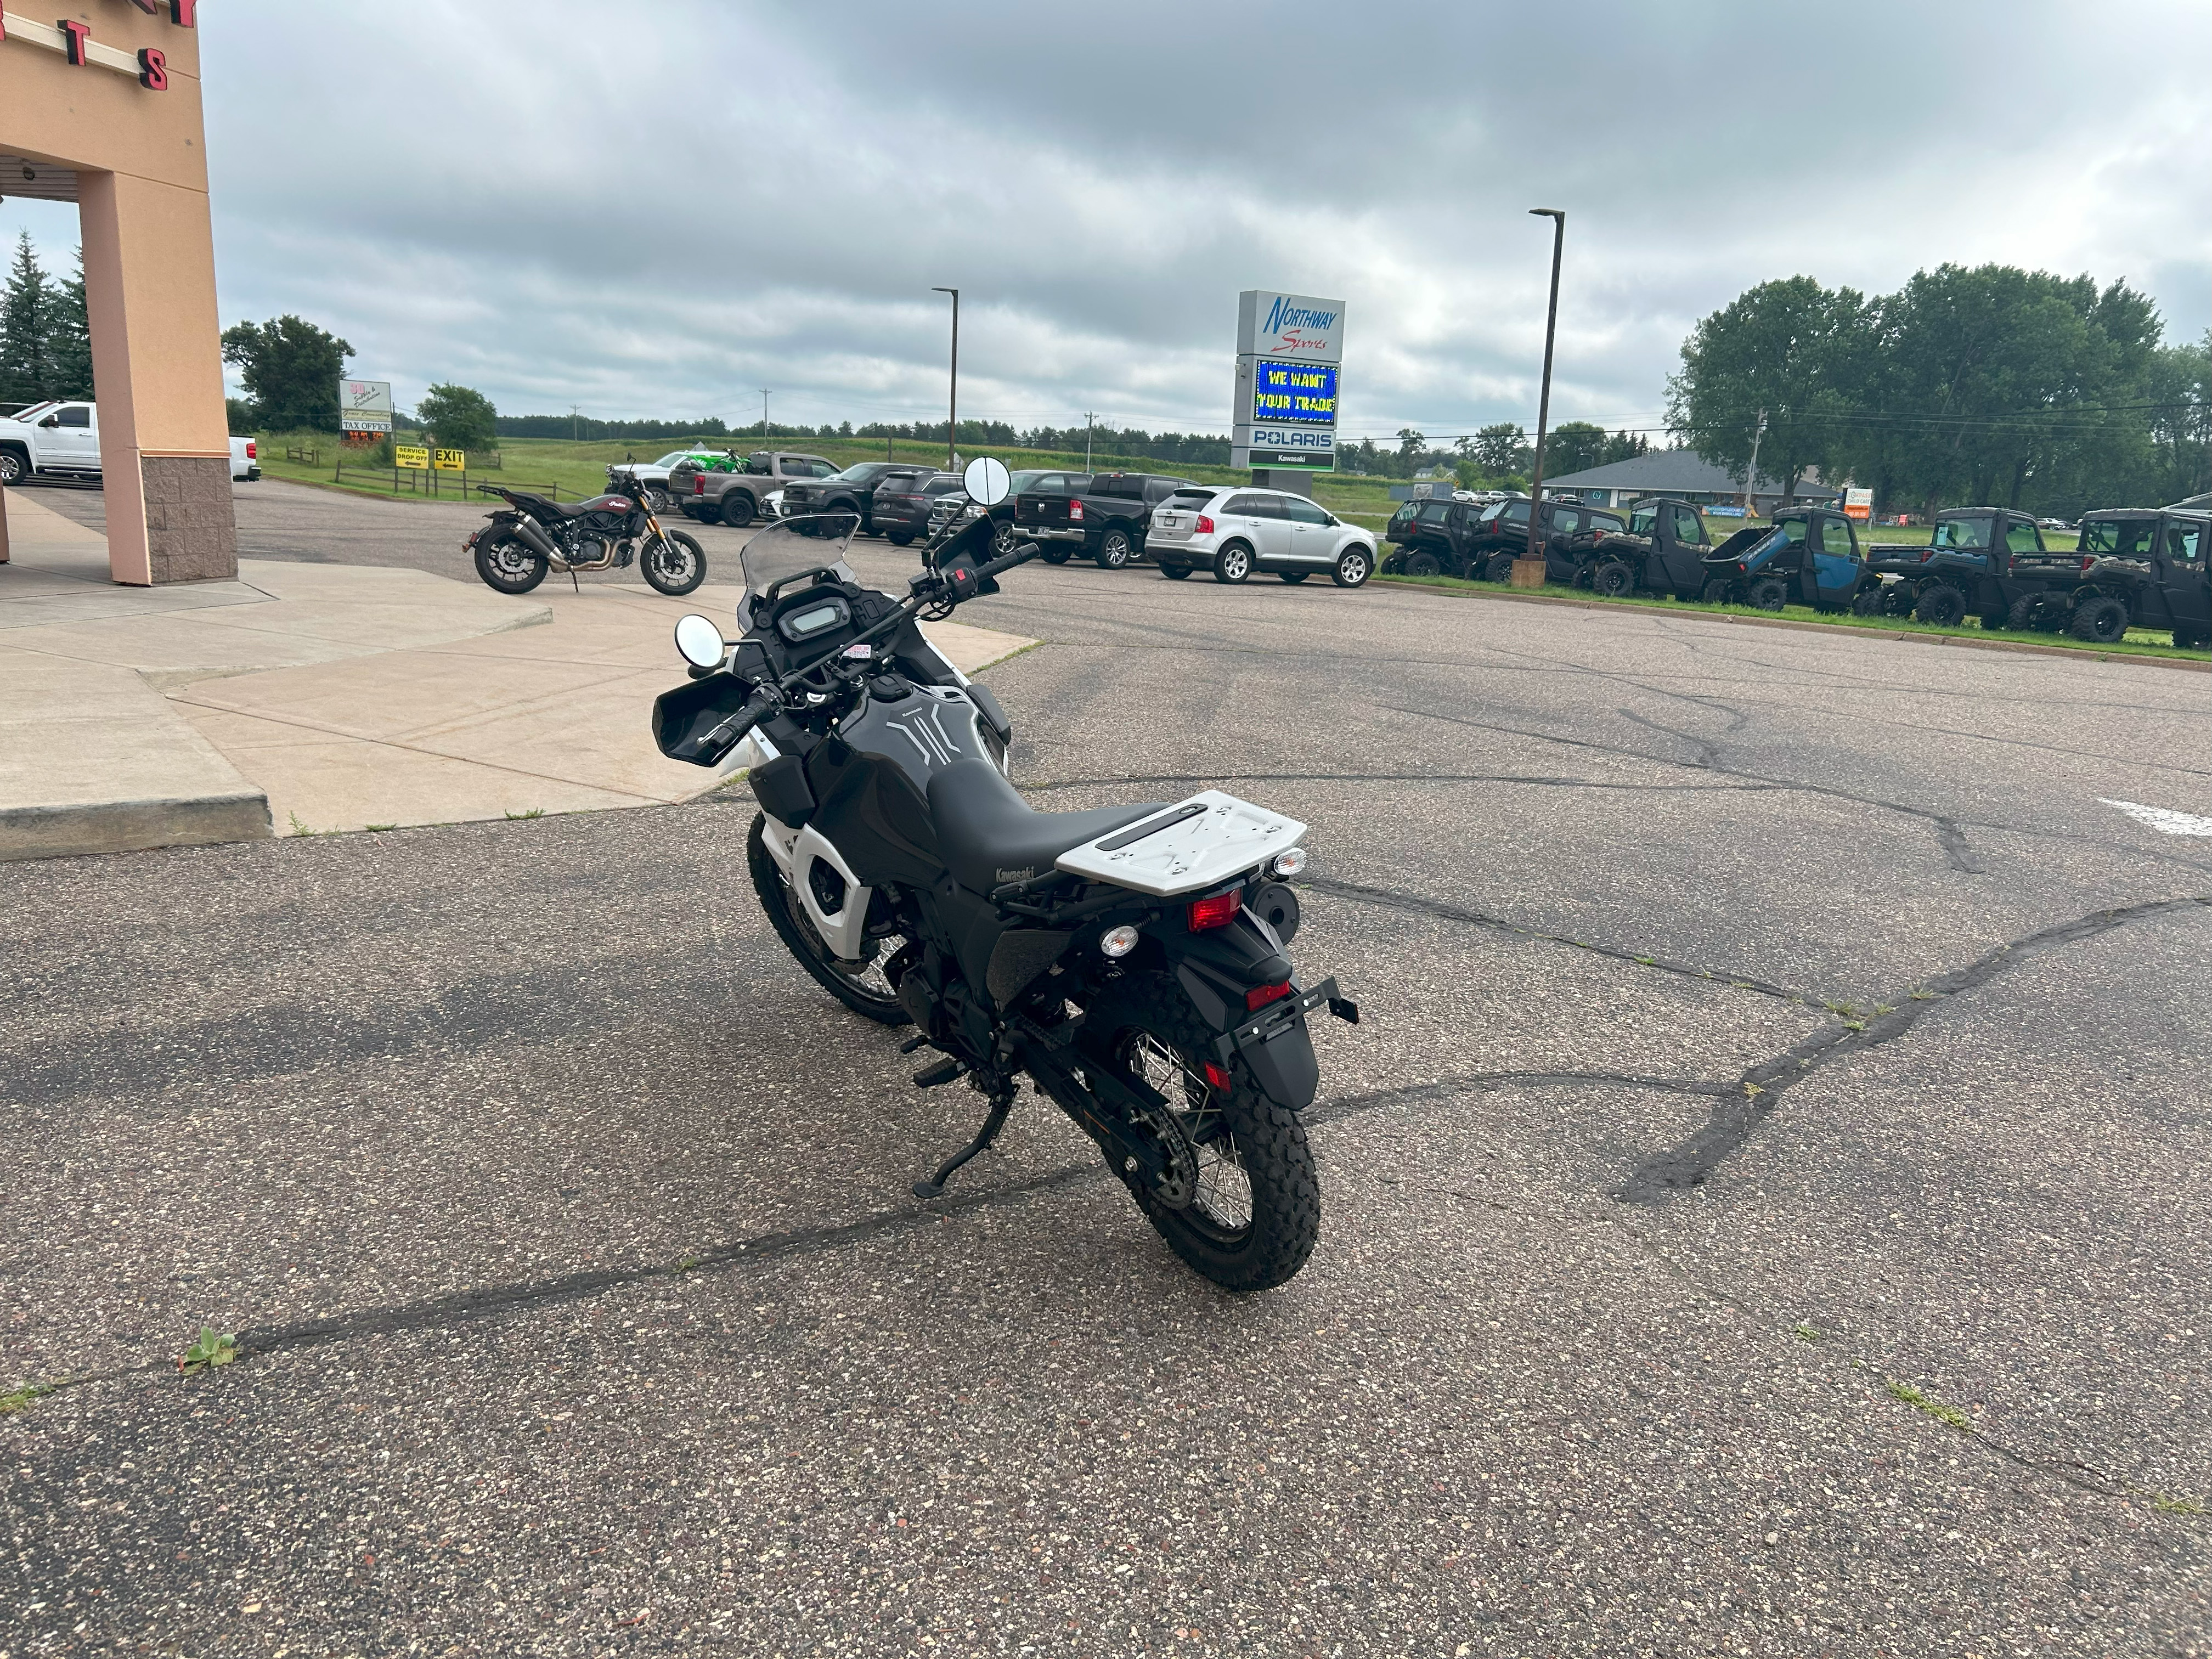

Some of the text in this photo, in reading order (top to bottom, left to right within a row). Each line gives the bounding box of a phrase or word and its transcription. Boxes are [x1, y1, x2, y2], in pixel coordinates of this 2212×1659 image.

[1262, 296, 1338, 334] NORTHWAY
[1270, 329, 1328, 353] Sports
[1269, 370, 1327, 388] WE WANT
[1257, 393, 1333, 411] YOUR TRADE
[362, 422, 391, 431] OFFICE
[1254, 431, 1332, 447] POLARIS
[435, 450, 463, 462] EXIT
[901, 707, 923, 717] Kawasaki
[996, 866, 1034, 883] Kawasaki
